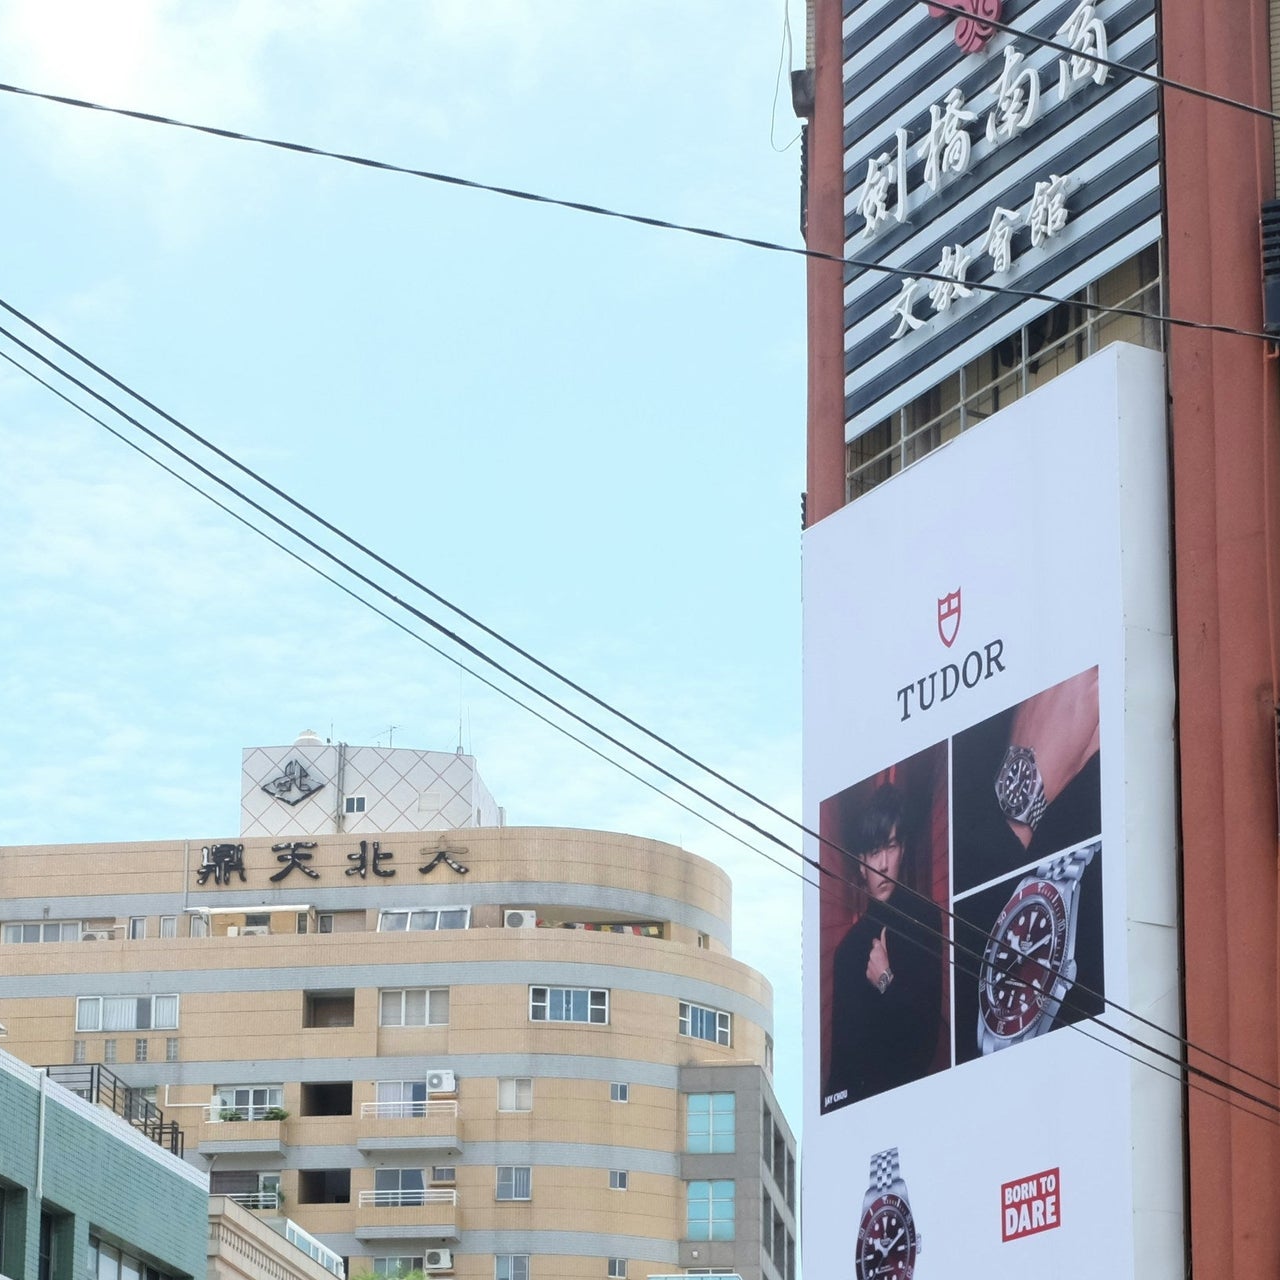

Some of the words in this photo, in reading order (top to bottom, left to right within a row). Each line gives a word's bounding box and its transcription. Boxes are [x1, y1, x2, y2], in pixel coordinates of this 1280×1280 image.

[897, 638, 1006, 723] TUDOR
[1005, 1180, 1037, 1205] BORN
[1040, 1174, 1056, 1195] TO
[1005, 1195, 1057, 1236] DARE
